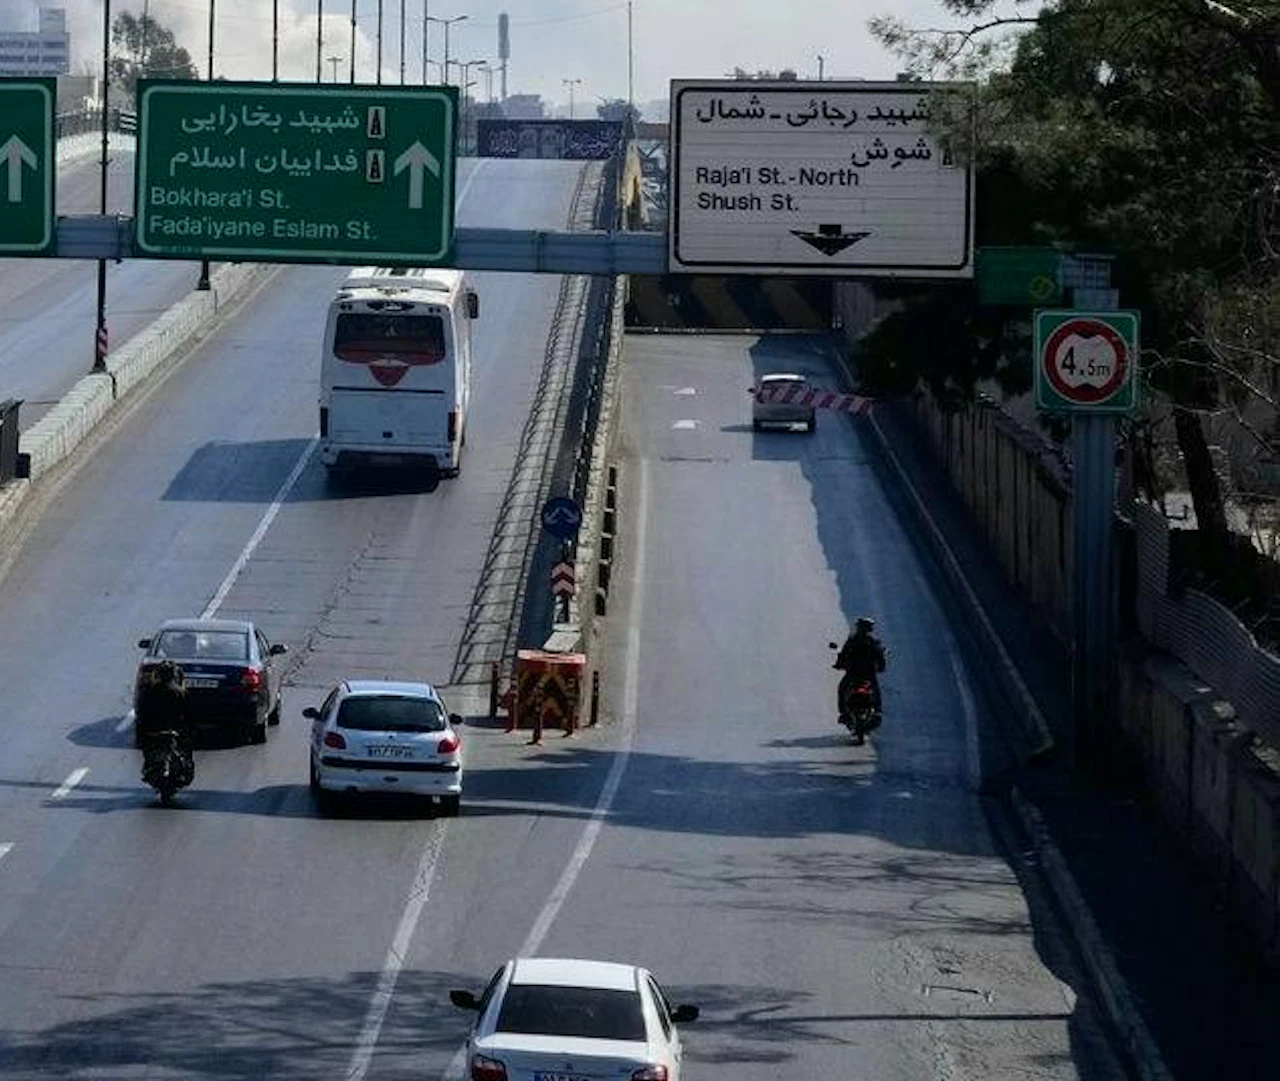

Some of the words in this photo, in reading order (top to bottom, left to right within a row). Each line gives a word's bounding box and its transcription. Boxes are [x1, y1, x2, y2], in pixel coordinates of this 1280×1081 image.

[180, 104, 283, 135] بخارایی
[289, 105, 361, 136] شهید
[695, 94, 766, 123] شمال
[168, 147, 245, 177] اسلام
[254, 147, 359, 177] فداییان
[851, 137, 932, 169] شوش
[151, 187, 253, 208] Bokhara'i
[259, 188, 290, 209] St.
[697, 193, 762, 211] Shush
[770, 194, 800, 212] St.
[149, 215, 266, 240] Fada'iyane
[272, 219, 340, 239] Eslam
[346, 221, 379, 241] St.
